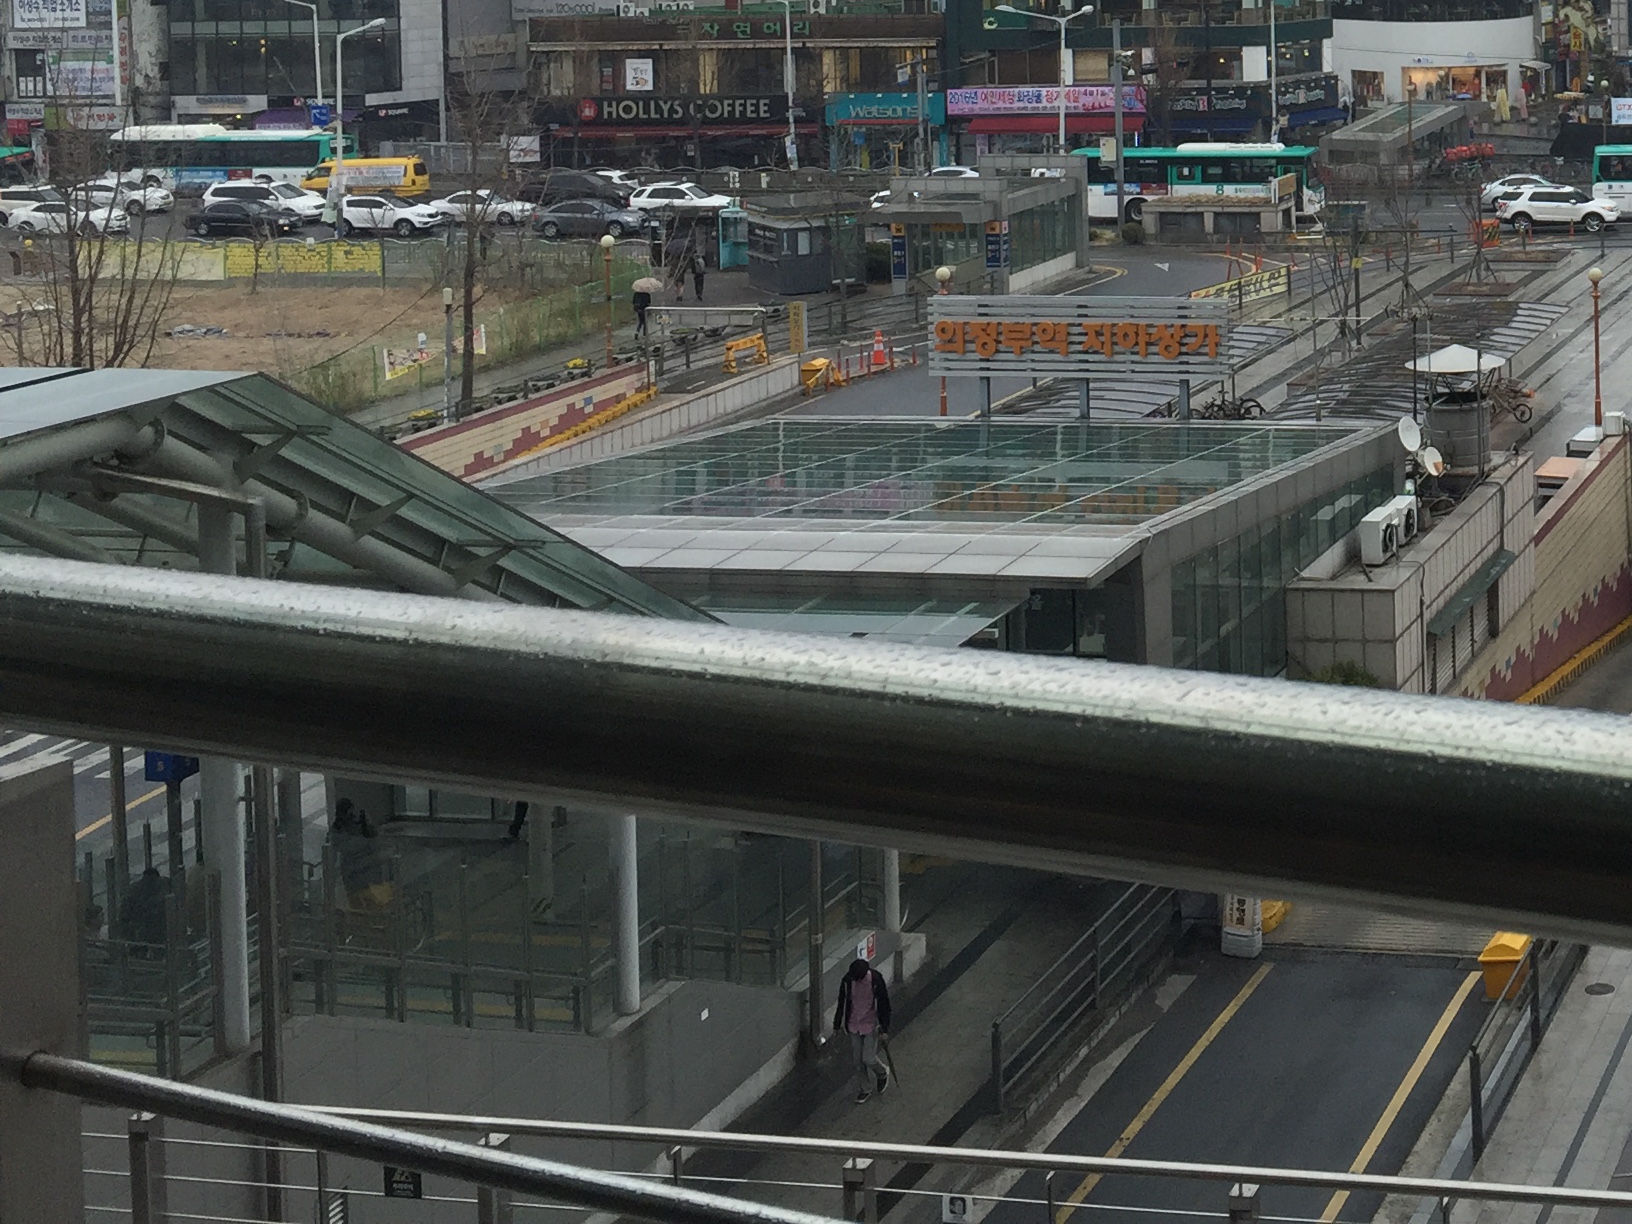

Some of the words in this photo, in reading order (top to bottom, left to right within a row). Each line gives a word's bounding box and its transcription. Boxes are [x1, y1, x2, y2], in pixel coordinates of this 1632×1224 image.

[948, 90, 978, 105] 2016년
[1016, 90, 1043, 104] 화장품
[603, 99, 683, 120] HOLLYS
[934, 320, 1069, 358] 의정부역
[1082, 322, 1221, 360] 지하상가
